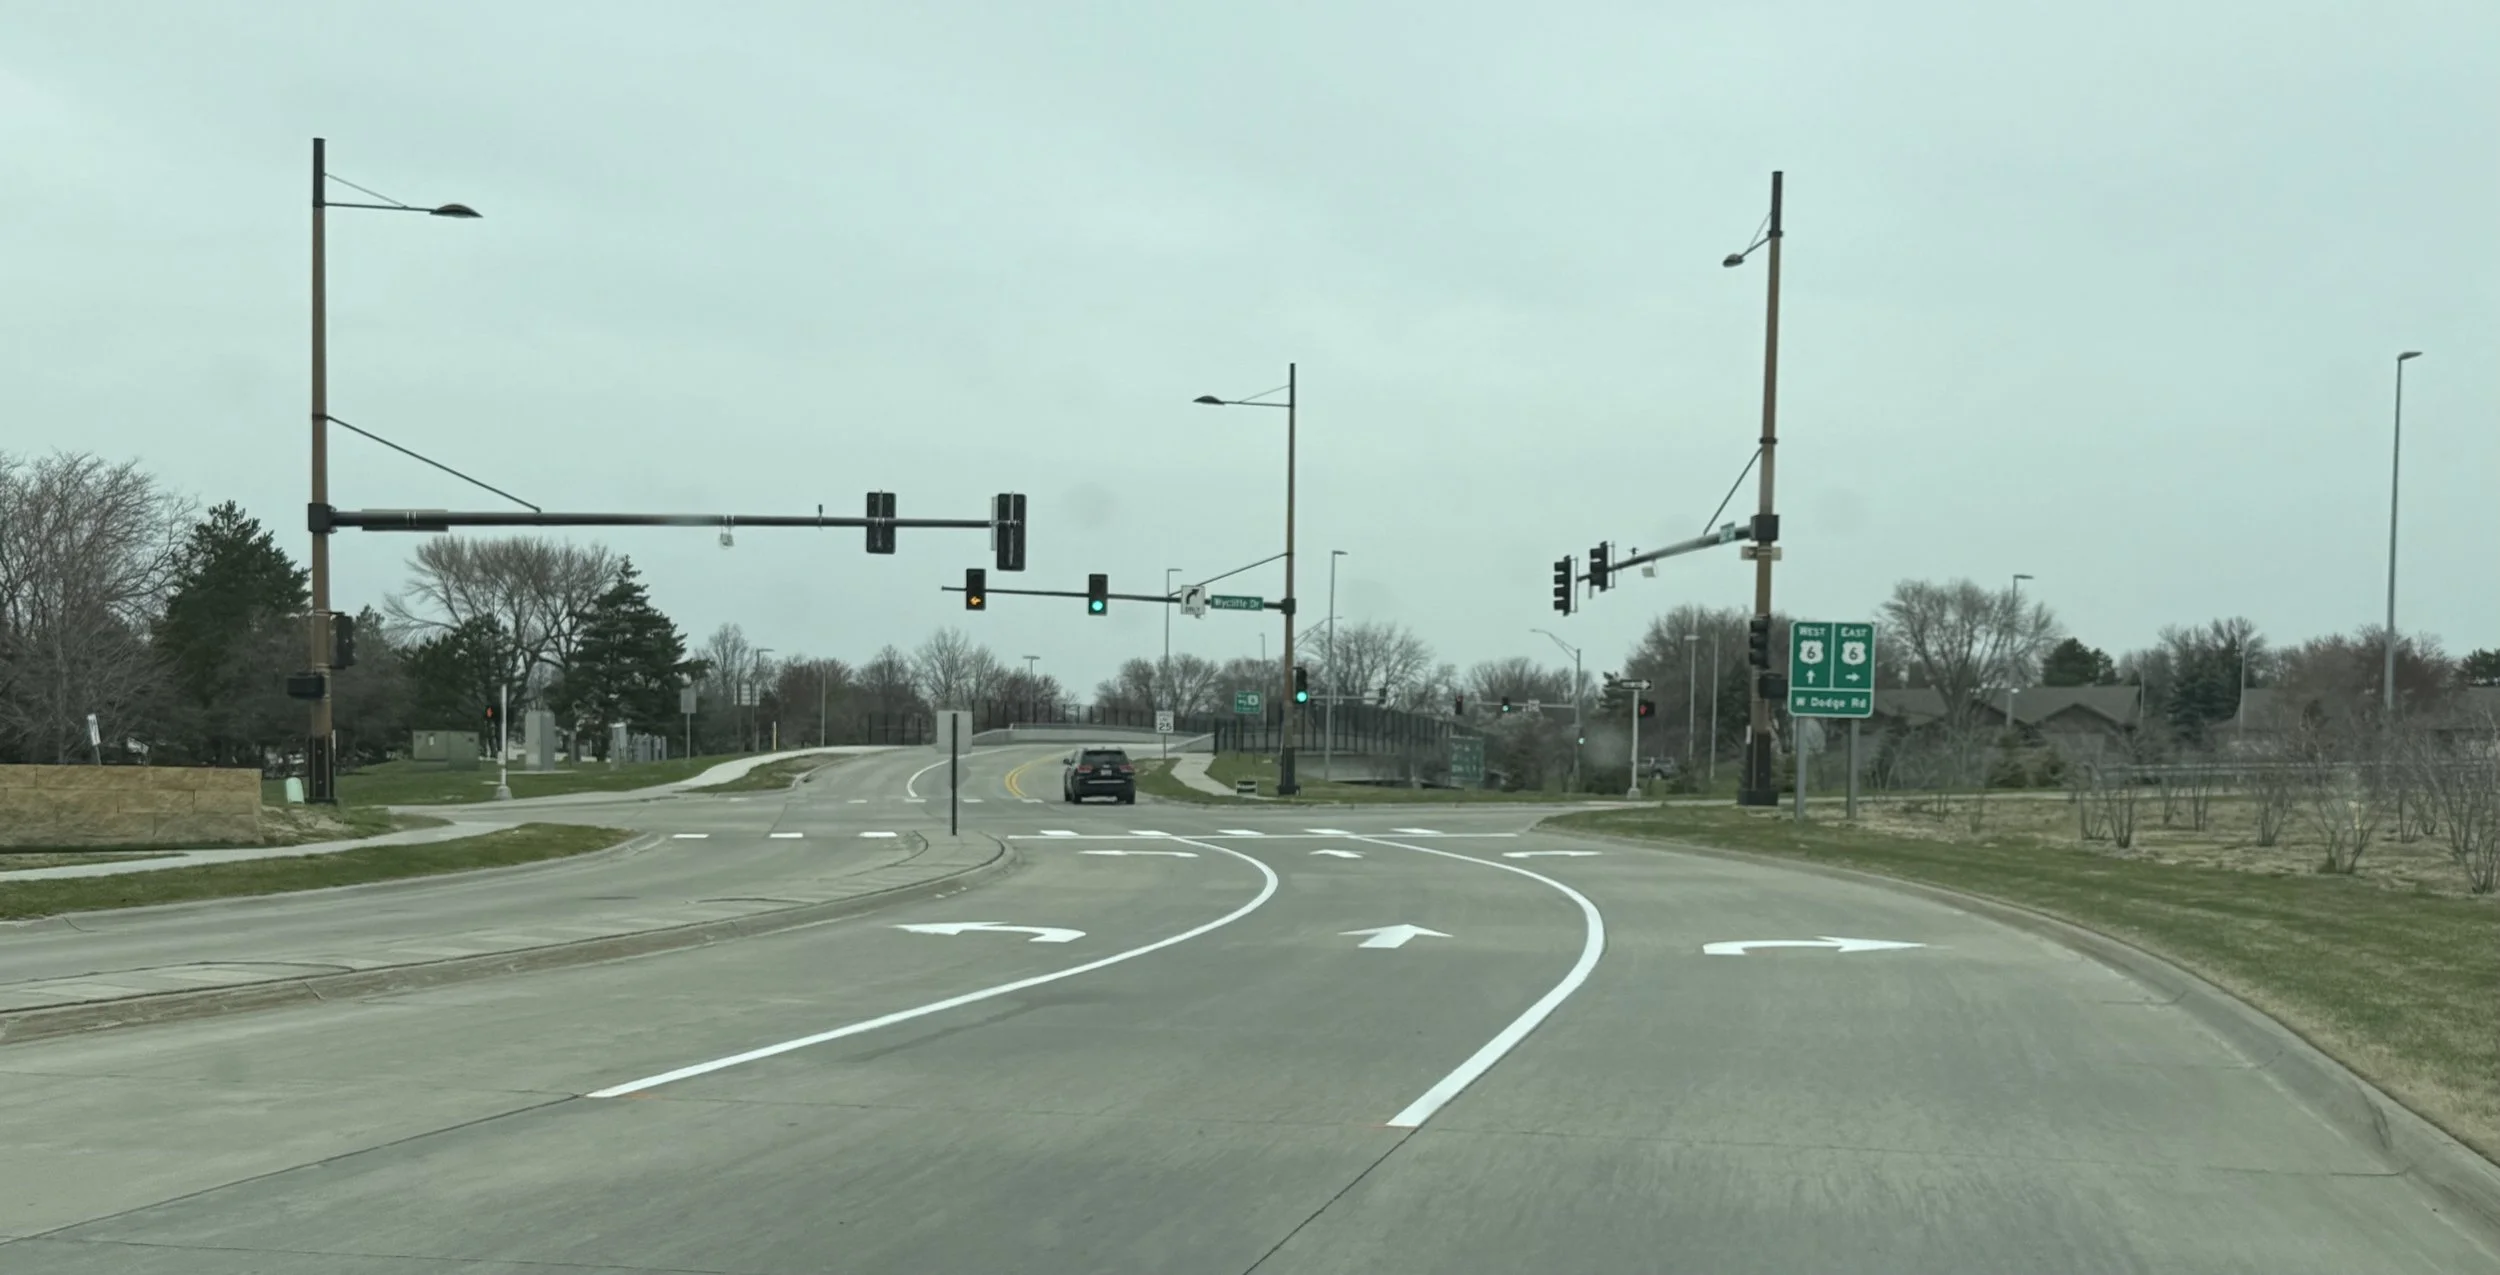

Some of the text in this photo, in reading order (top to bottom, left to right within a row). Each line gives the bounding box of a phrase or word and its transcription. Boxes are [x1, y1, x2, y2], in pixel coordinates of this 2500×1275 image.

[1799, 626, 1826, 636] WEST
[1840, 627, 1867, 637] EAST
[1806, 646, 1816, 659] 6
[1849, 647, 1858, 660] 6
[1795, 697, 1866, 710] W Dodge Rd
[1159, 722, 1172, 732] 25
